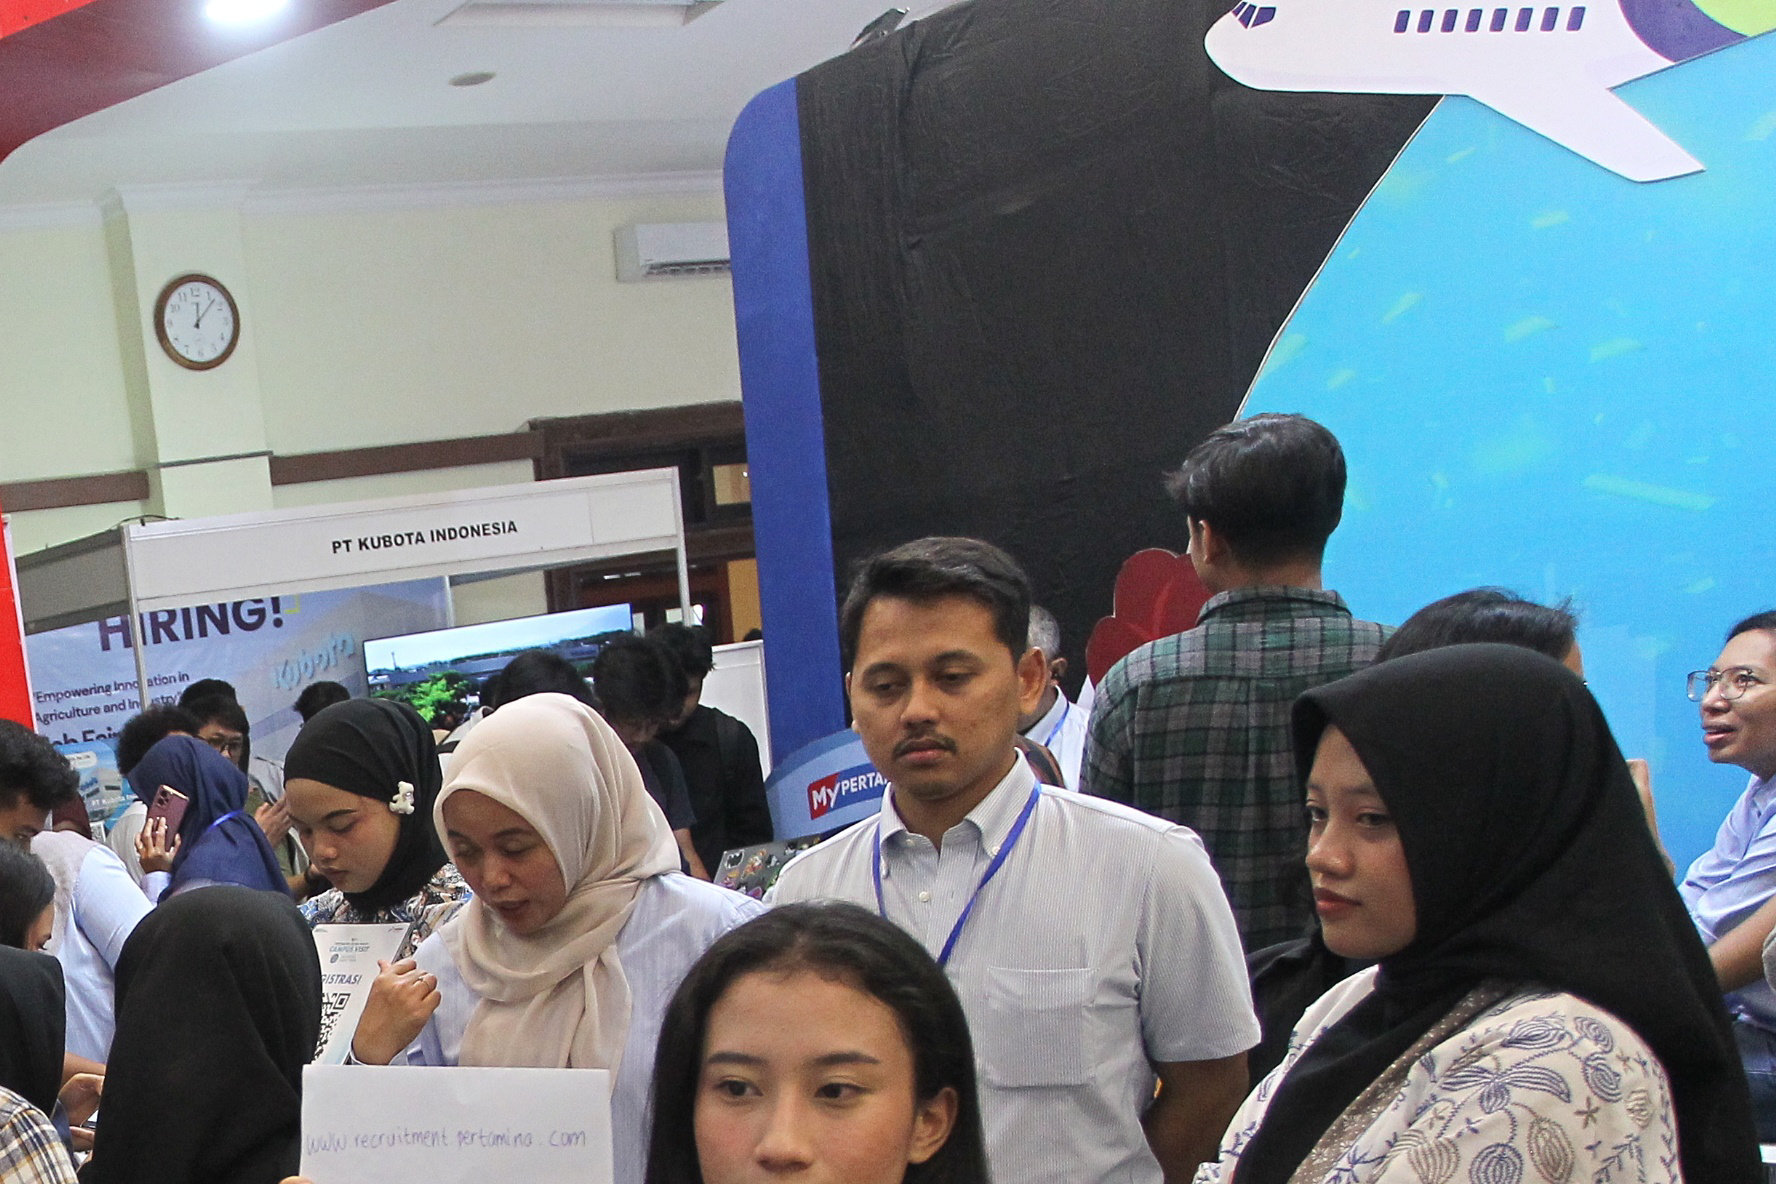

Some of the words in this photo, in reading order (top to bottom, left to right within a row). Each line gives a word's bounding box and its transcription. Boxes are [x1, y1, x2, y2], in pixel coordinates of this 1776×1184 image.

[331, 538, 352, 554] PT
[357, 531, 426, 551] KUBOTA
[430, 519, 519, 542] INDONESIA
[113, 673, 177, 691] Innoation
[178, 671, 189, 682] in
[35, 706, 101, 726] Agriculture
[104, 699, 126, 712] and
[321, 974, 363, 985] GISTRASI
